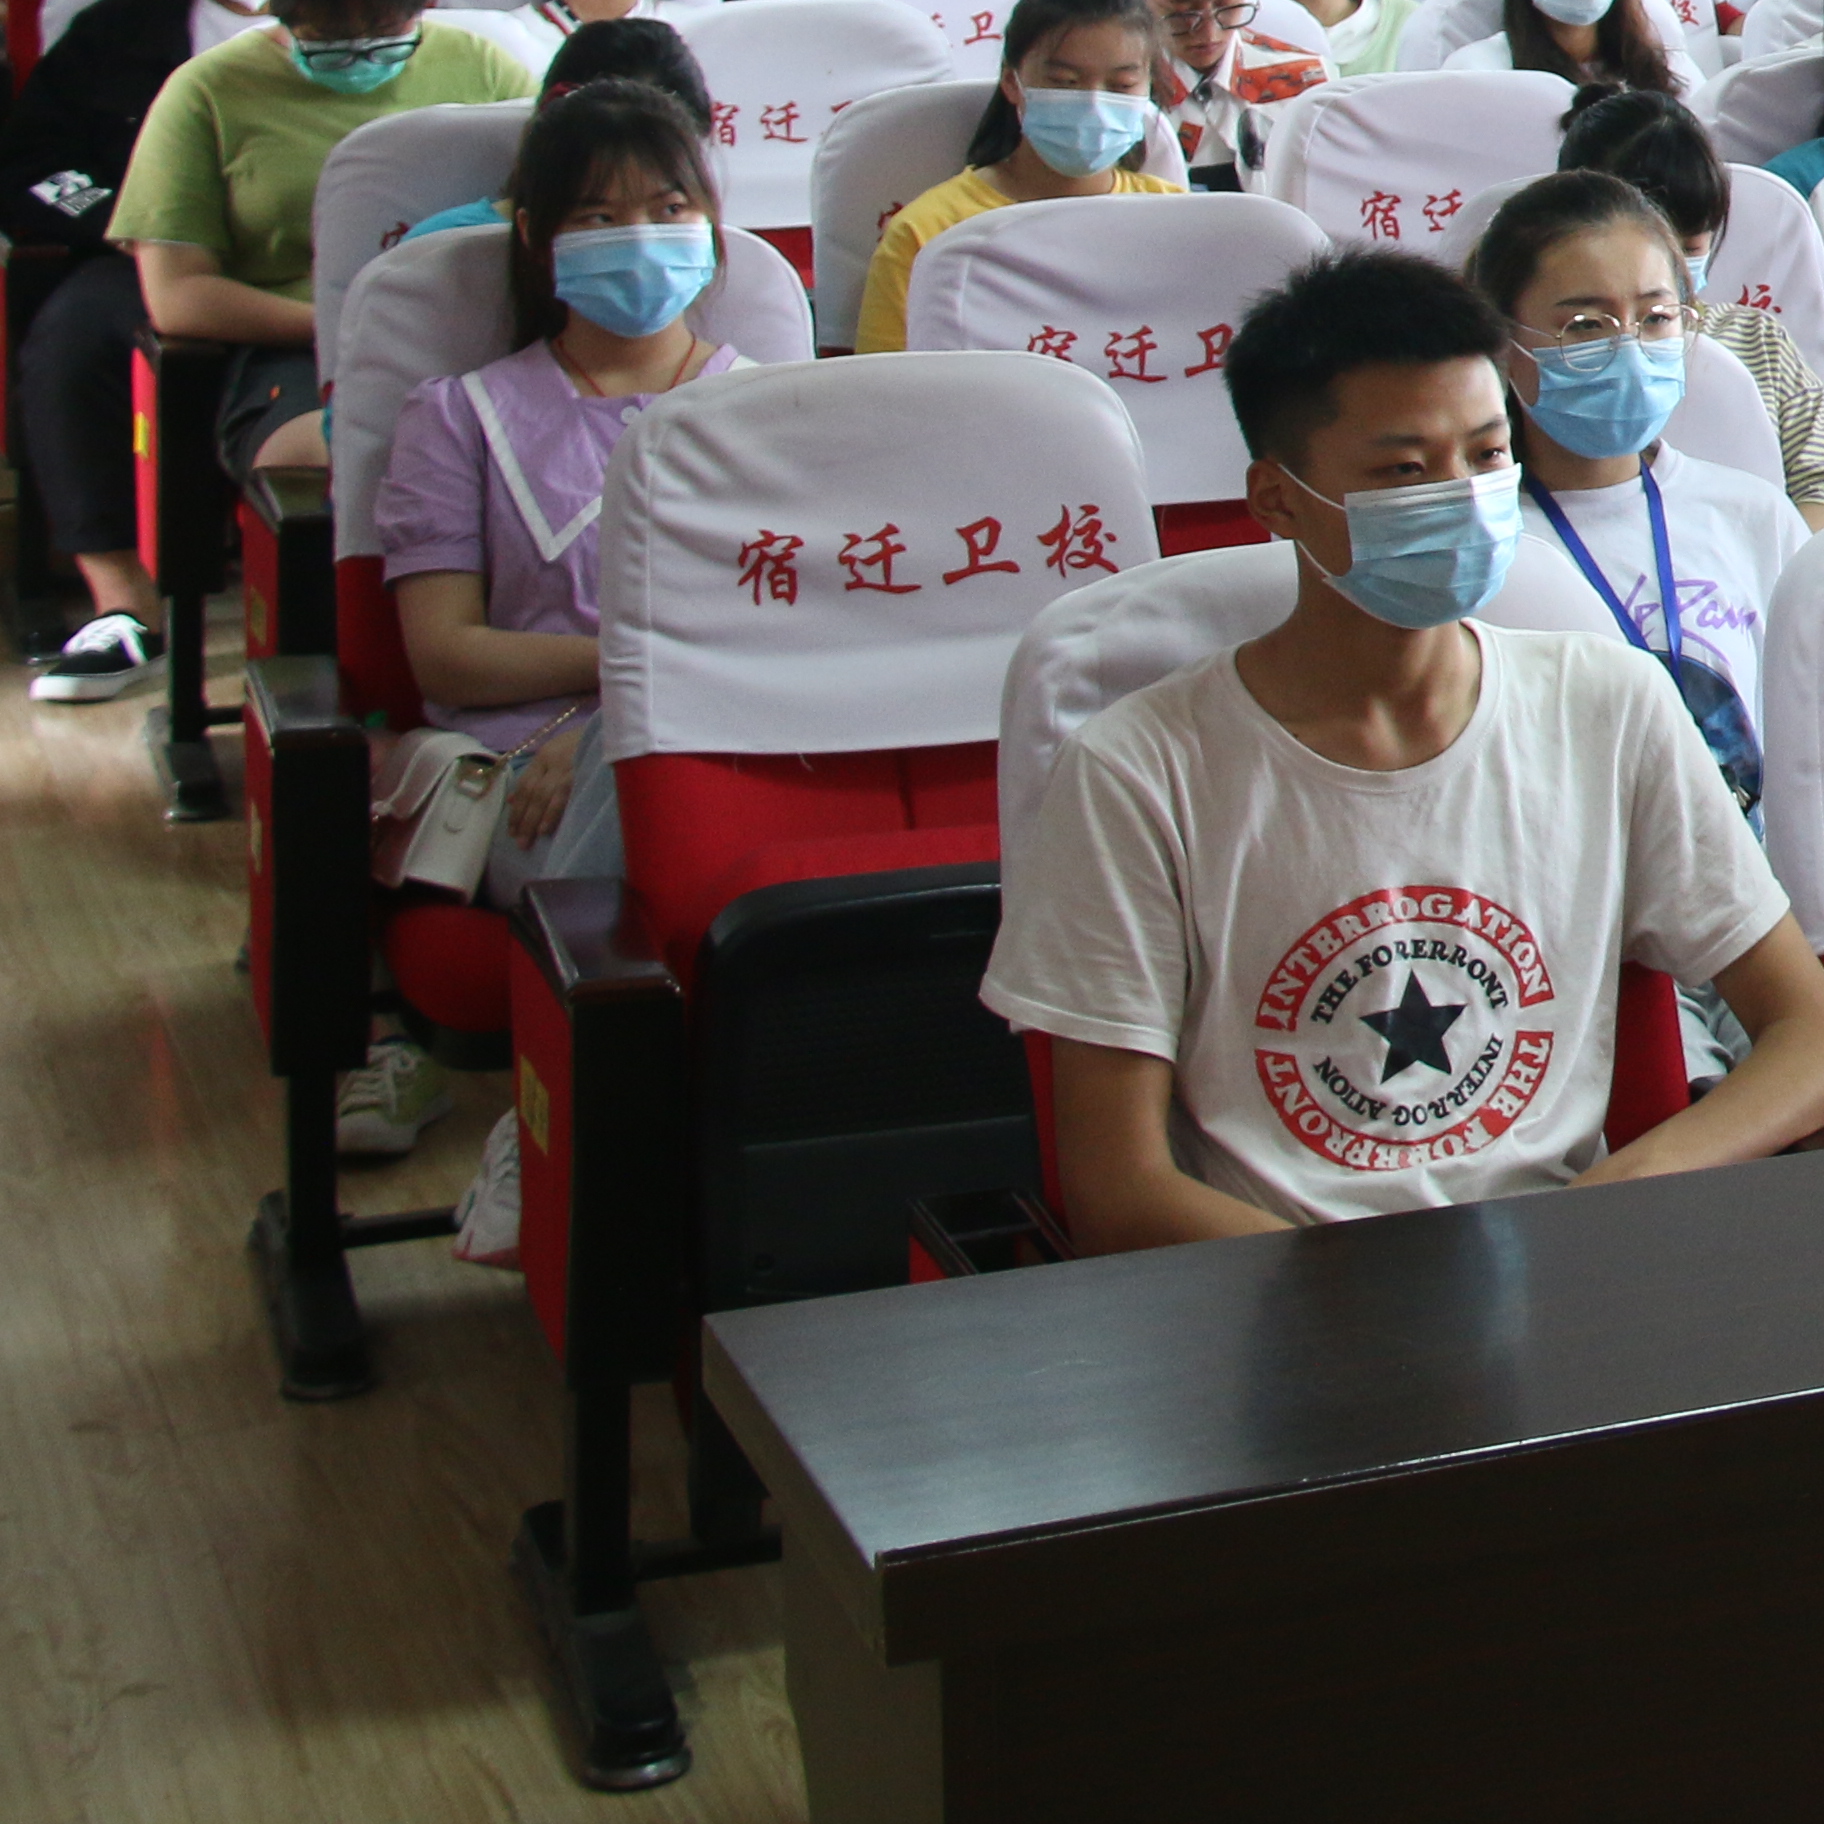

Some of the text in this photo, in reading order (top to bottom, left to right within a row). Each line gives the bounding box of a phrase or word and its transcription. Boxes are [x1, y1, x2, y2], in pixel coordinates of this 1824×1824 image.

[710, 100, 850, 146] 宿迁
[736, 503, 1121, 607] 宿迁卫校
[1260, 893, 1549, 1026] INTERROGATION
[1310, 969, 1358, 1024] THE
[1490, 1038, 1549, 1119] THE
